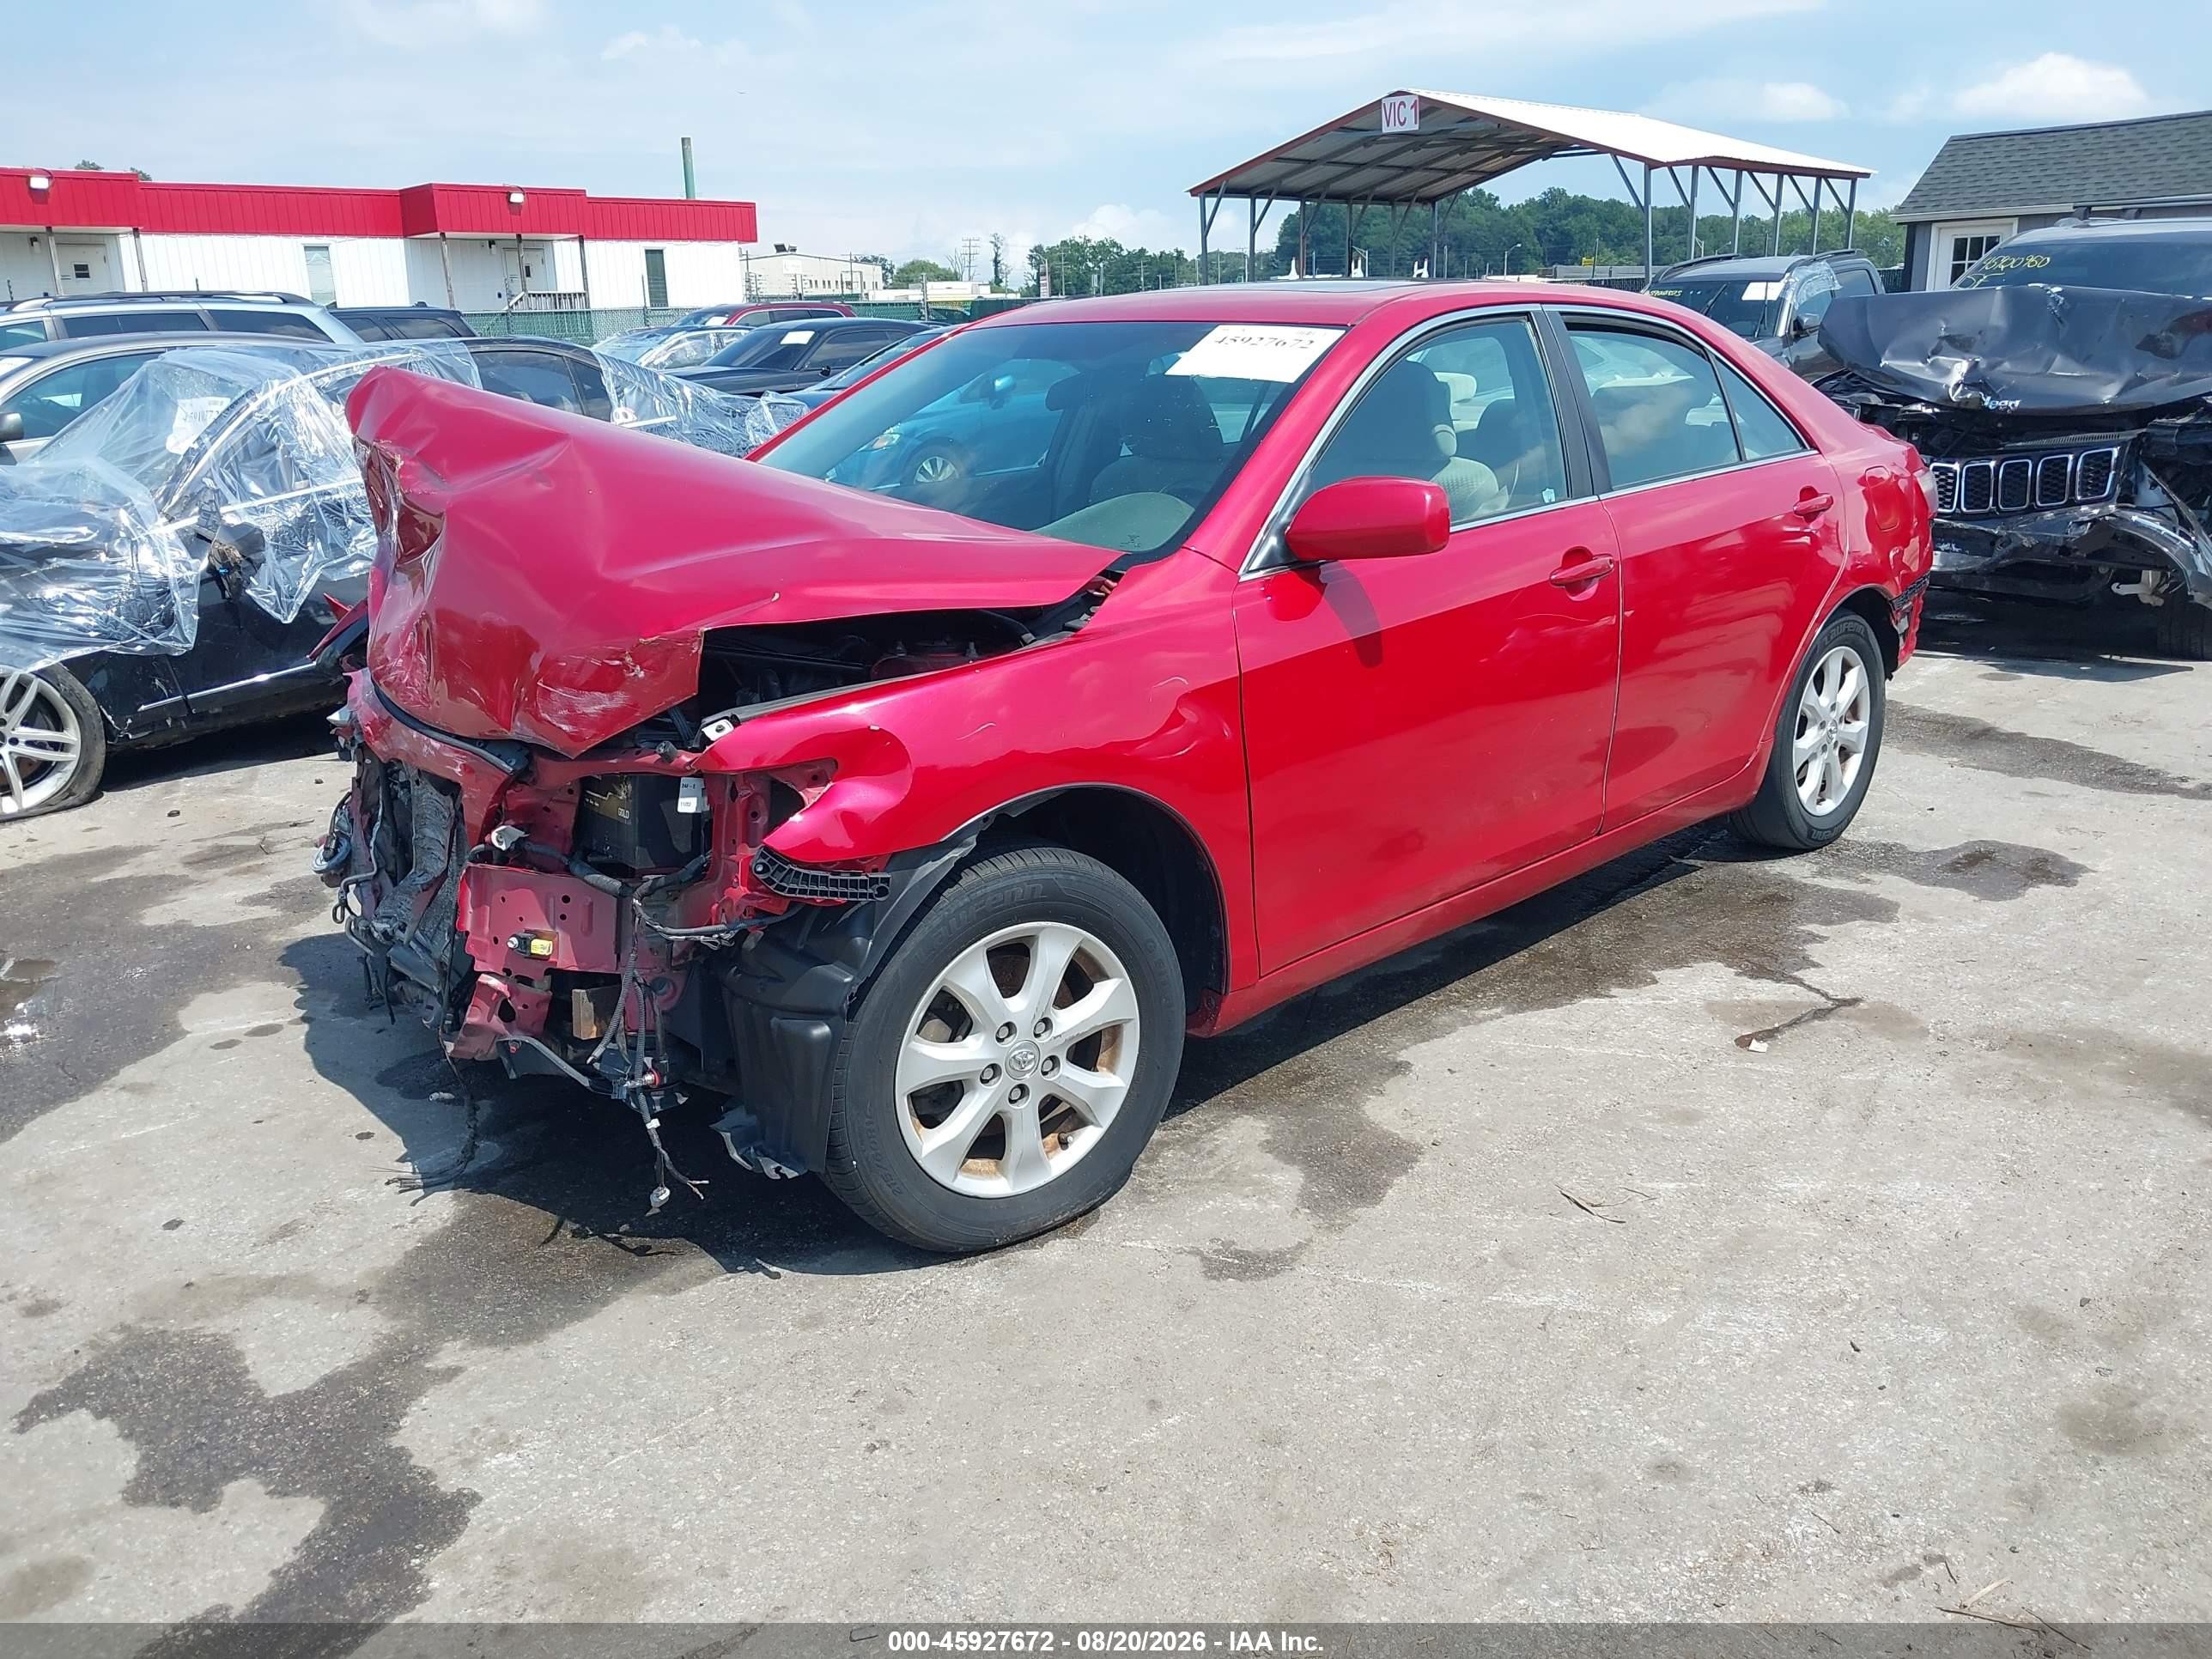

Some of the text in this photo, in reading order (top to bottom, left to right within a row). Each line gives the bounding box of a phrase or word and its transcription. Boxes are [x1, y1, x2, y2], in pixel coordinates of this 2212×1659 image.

[1382, 99, 1419, 127] VIC 1
[1214, 336, 1315, 349] 45927672
